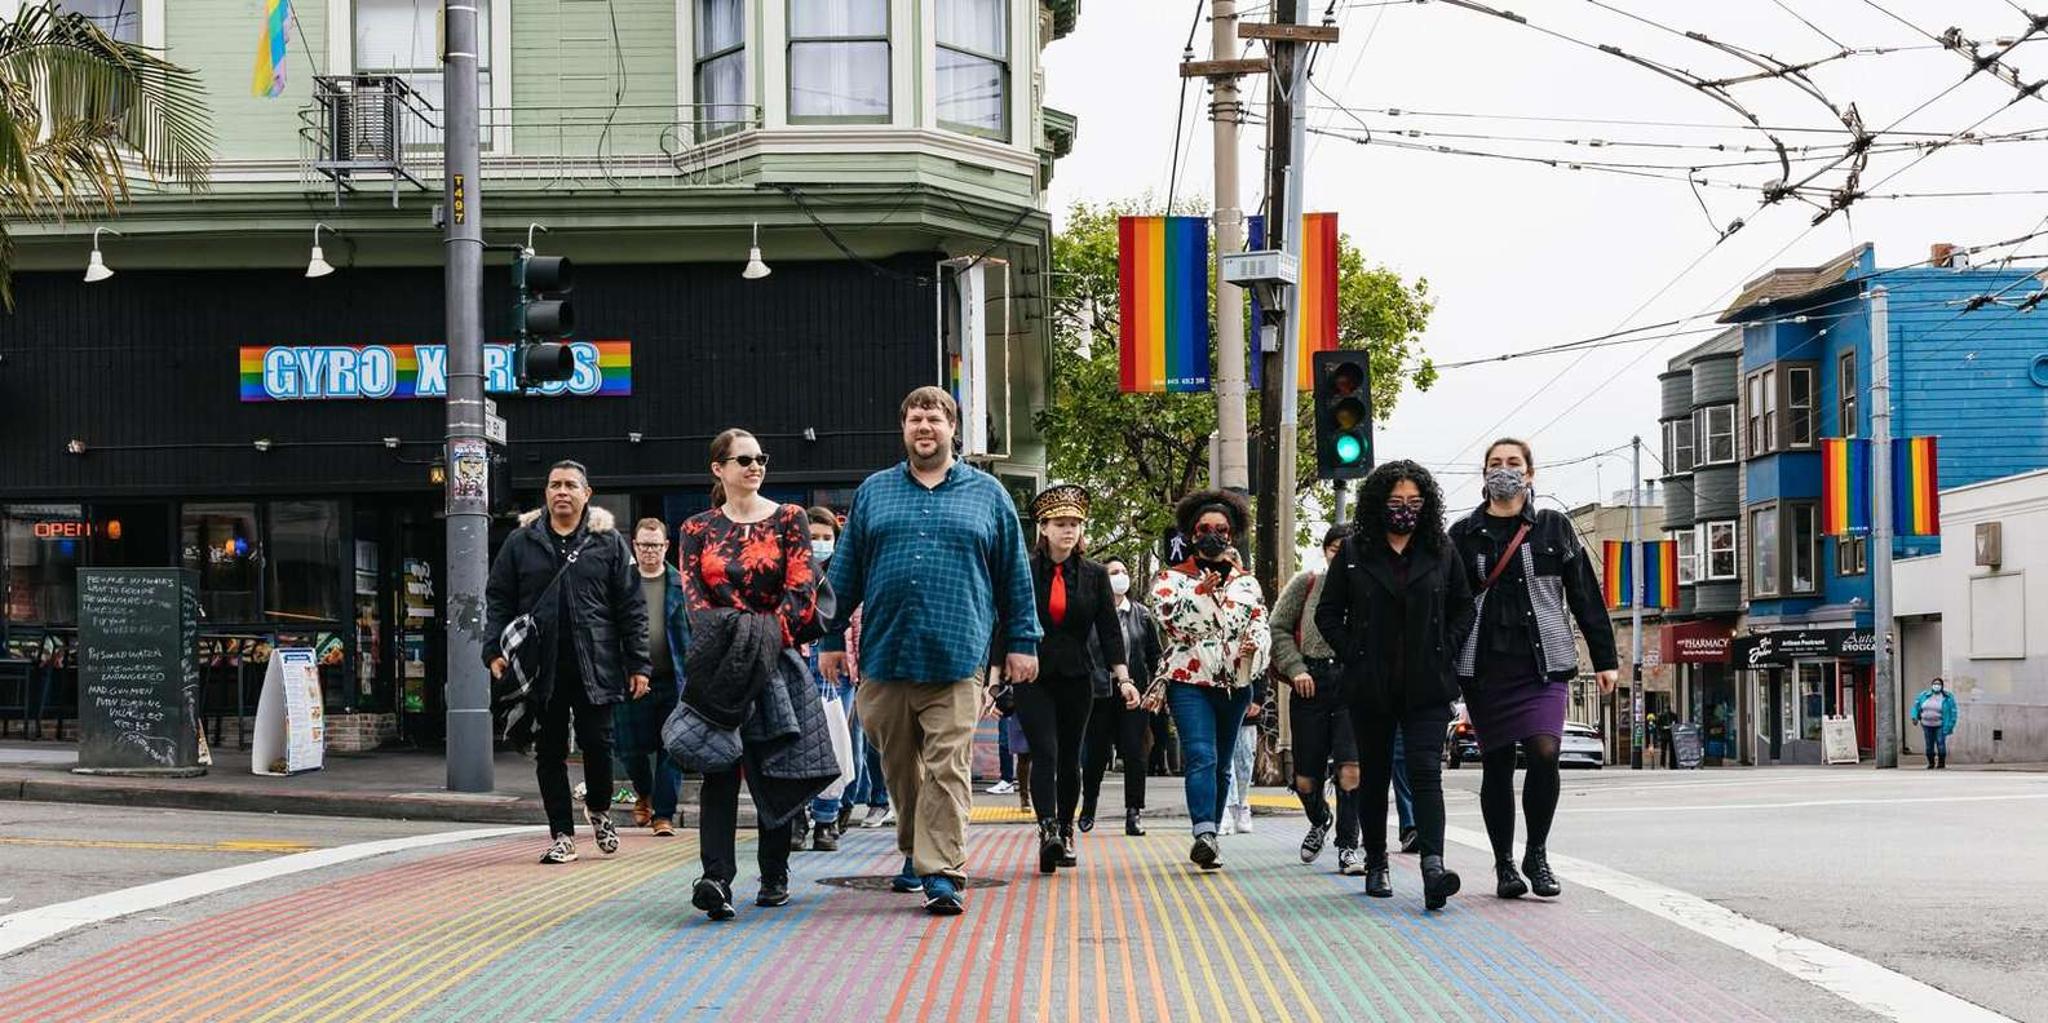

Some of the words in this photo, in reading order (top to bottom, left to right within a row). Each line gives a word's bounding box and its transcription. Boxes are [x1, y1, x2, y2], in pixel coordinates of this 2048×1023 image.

[454, 176, 463, 222] T497
[263, 345, 396, 398] GYRO
[414, 342, 602, 396] XRS
[34, 522, 91, 537] OPEN
[1684, 638, 1729, 648] PHARMACY
